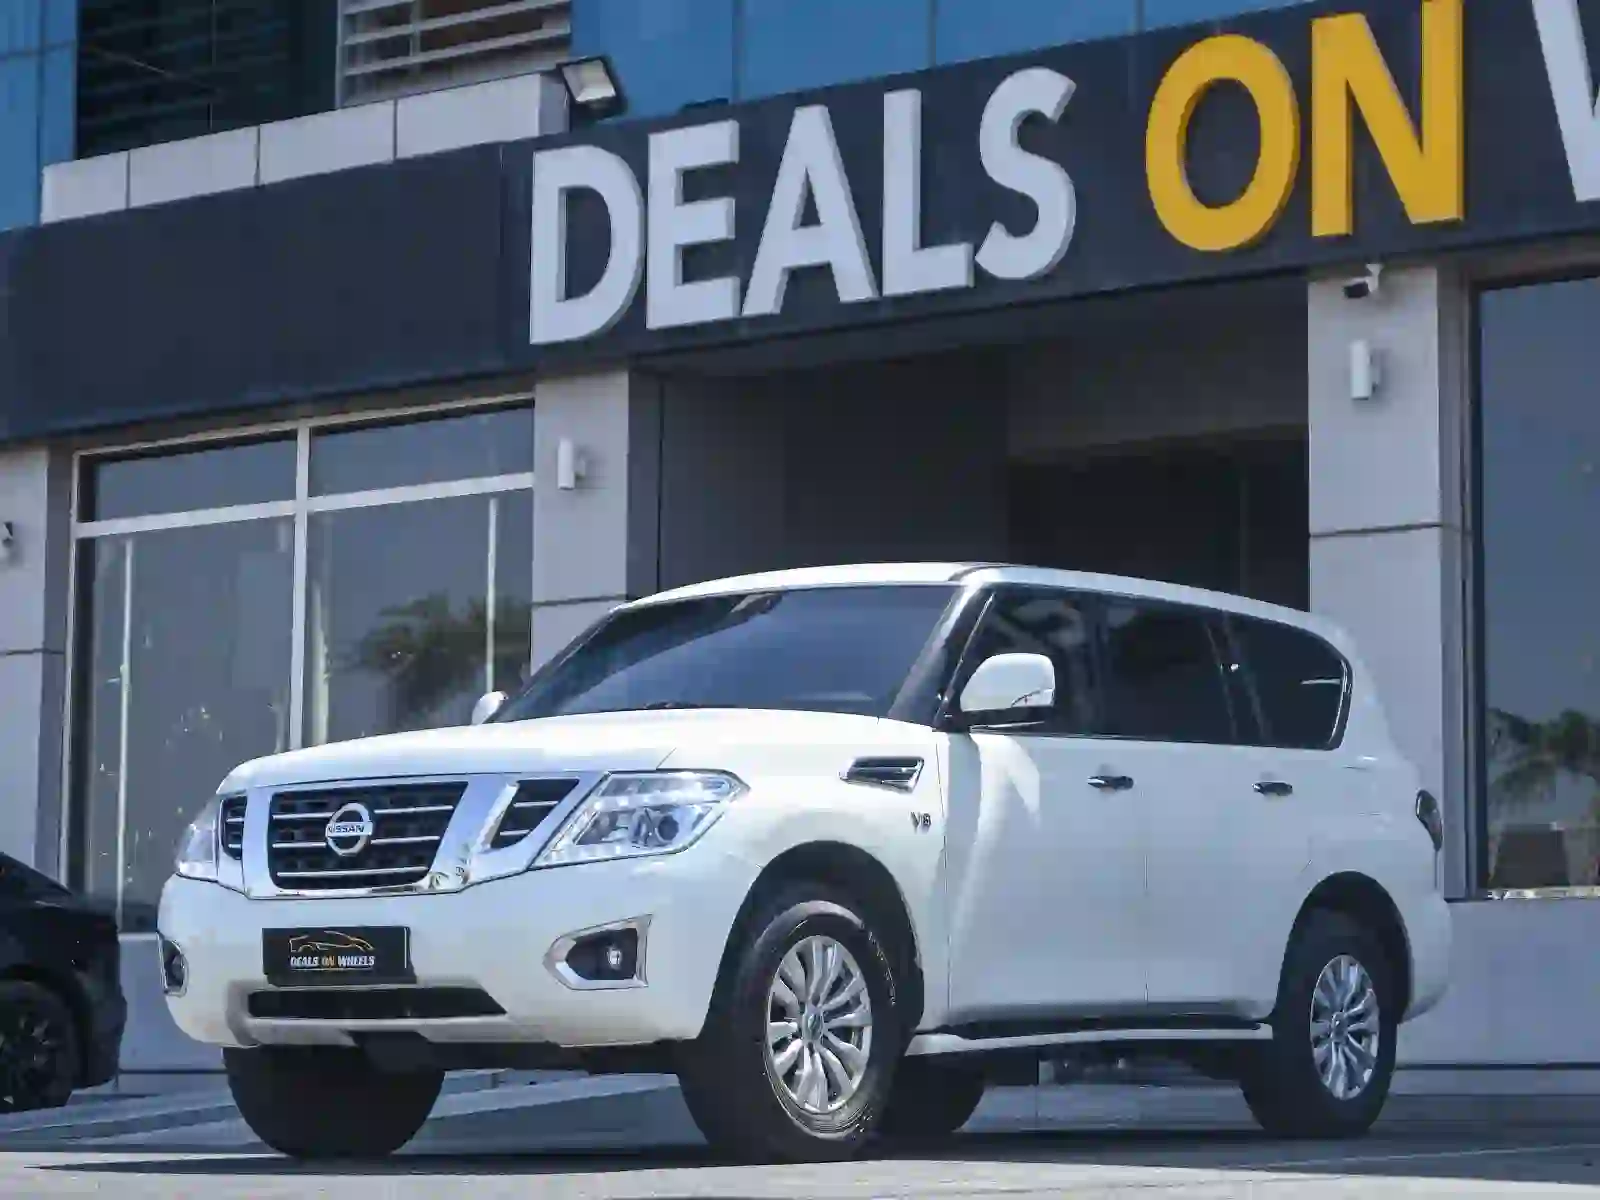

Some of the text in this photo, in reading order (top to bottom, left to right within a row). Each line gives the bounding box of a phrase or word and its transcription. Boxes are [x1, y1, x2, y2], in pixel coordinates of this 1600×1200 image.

[530, 67, 1077, 345] DEALS
[1145, 0, 1464, 251] ON
[327, 823, 366, 834] NISSAN
[290, 955, 376, 967] DEALS ON WHEELS
